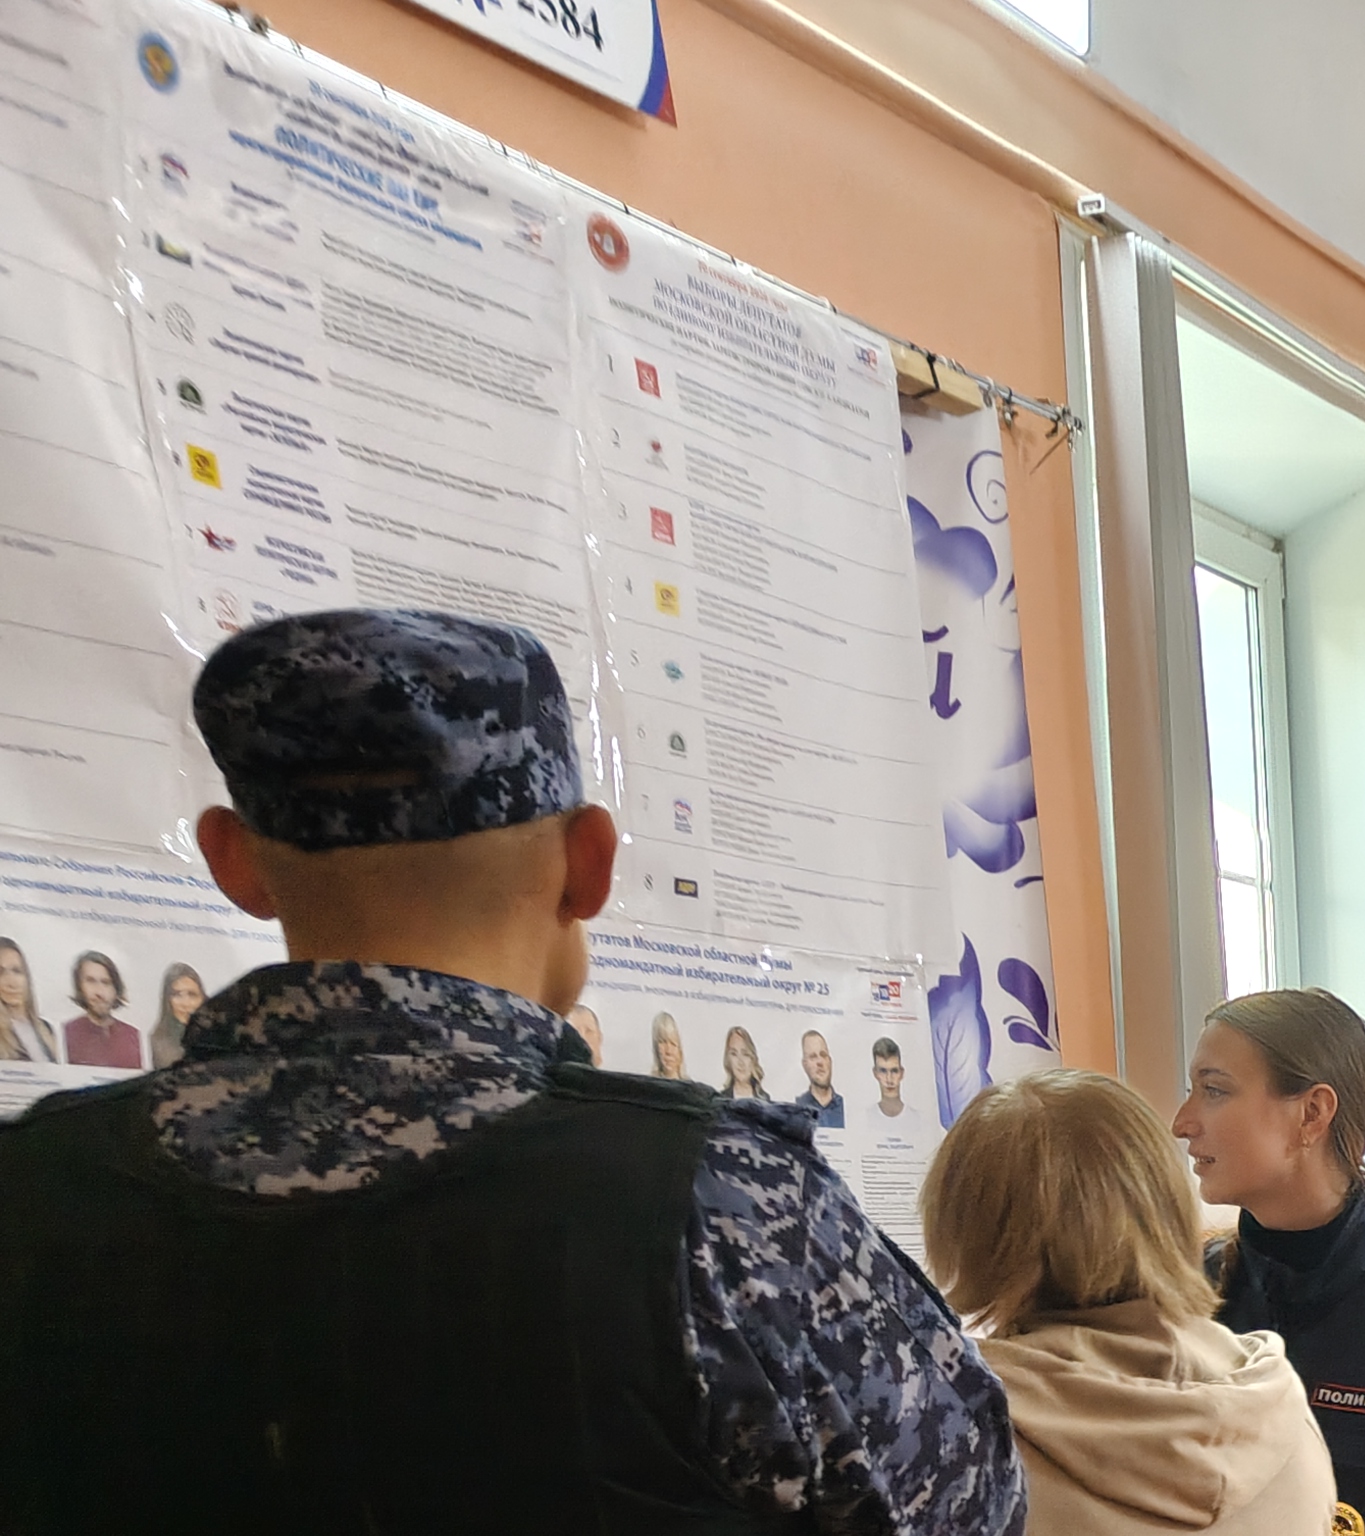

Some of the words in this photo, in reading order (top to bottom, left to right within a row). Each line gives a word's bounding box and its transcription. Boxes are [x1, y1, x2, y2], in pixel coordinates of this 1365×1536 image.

[632, 934, 702, 959] Московской
[703, 946, 758, 968] областной
[685, 964, 771, 989] избирательный
[771, 978, 802, 995] округ
[816, 982, 830, 996] 25
